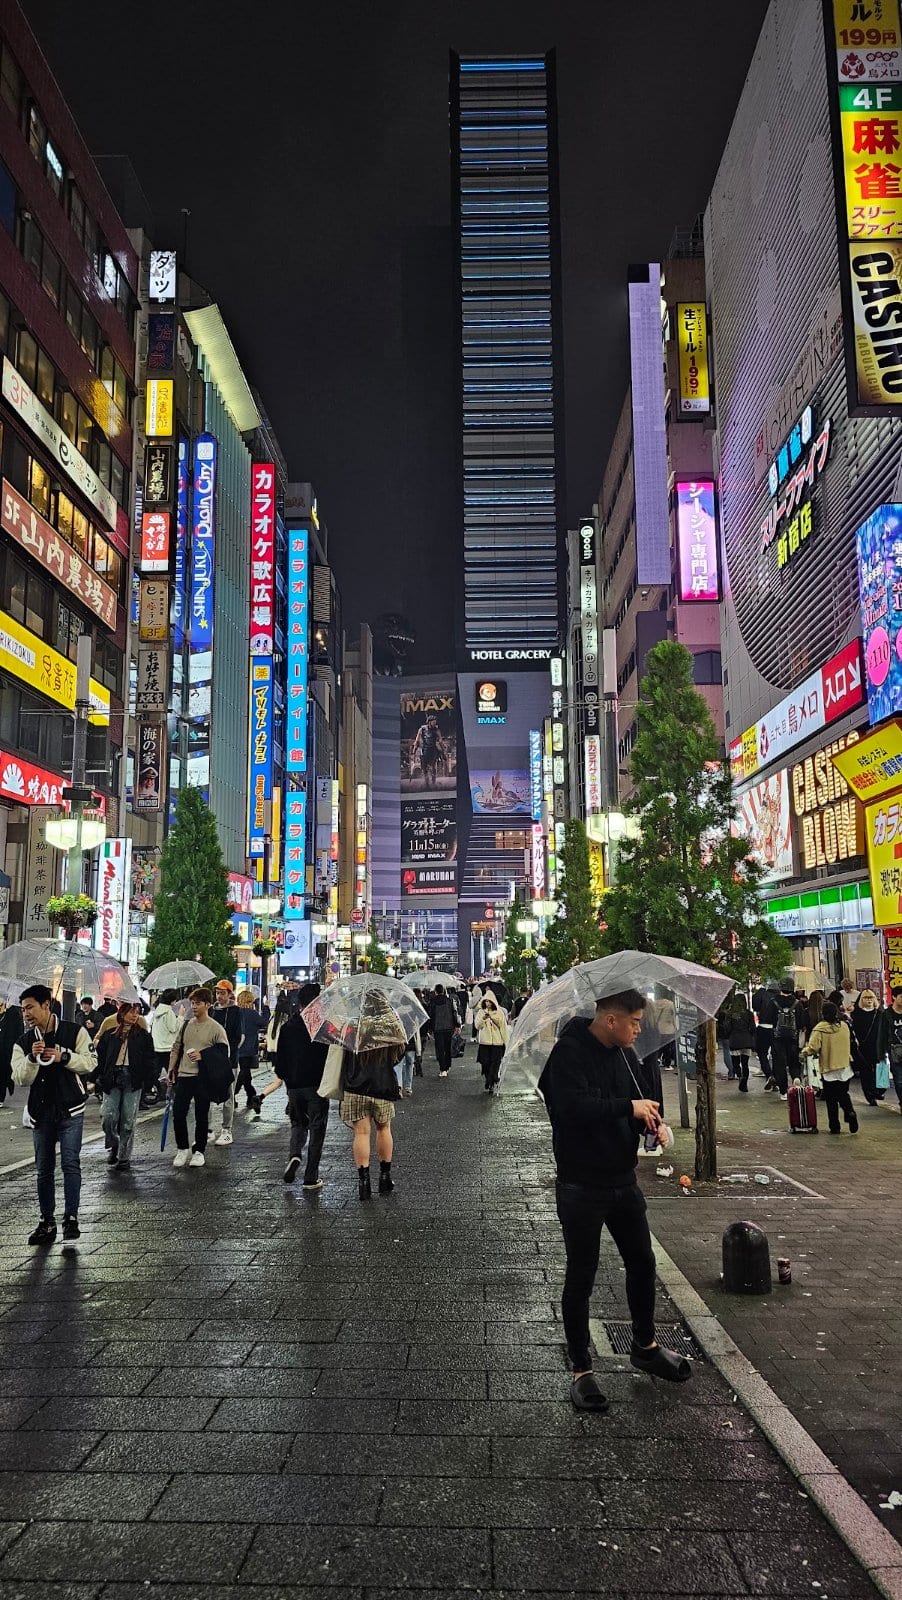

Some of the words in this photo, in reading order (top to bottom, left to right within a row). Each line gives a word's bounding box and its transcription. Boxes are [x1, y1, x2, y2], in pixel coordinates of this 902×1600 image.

[840, 28, 897, 46] 199円
[868, 68, 900, 78] 鳥メロ
[852, 88, 893, 110] 4F
[852, 117, 902, 199] 麻雀
[852, 206, 896, 220] スリー
[155, 254, 171, 294] ダーツ
[683, 308, 697, 353] 生ビール
[851, 252, 902, 394] CASINO
[688, 355, 699, 395] 199円
[856, 333, 883, 399] KABUKICHO
[9, 374, 28, 409] 3F
[252, 469, 272, 627] カラオケ歌広場
[580, 524, 594, 561] Booth
[689, 483, 709, 593] シーシャ専門店
[777, 500, 813, 569] 新宿店
[4, 494, 20, 526] 5F
[21, 511, 104, 616] 山内農場
[146, 627, 160, 637] 3F
[290, 538, 306, 762] カラオケ&パーティー館
[471, 650, 504, 660] HOTEL
[505, 649, 552, 660] GRACERY
[253, 685, 269, 764] マツモトキヨシ
[788, 689, 818, 736] 鳥メロ
[142, 726, 158, 765] 海の家
[26, 774, 58, 803] 焼肉屋
[409, 838, 449, 852] 11月15日(金)
[873, 803, 902, 847] カラ
[101, 859, 116, 907] Miami
[419, 870, 455, 882] MARUHAN
